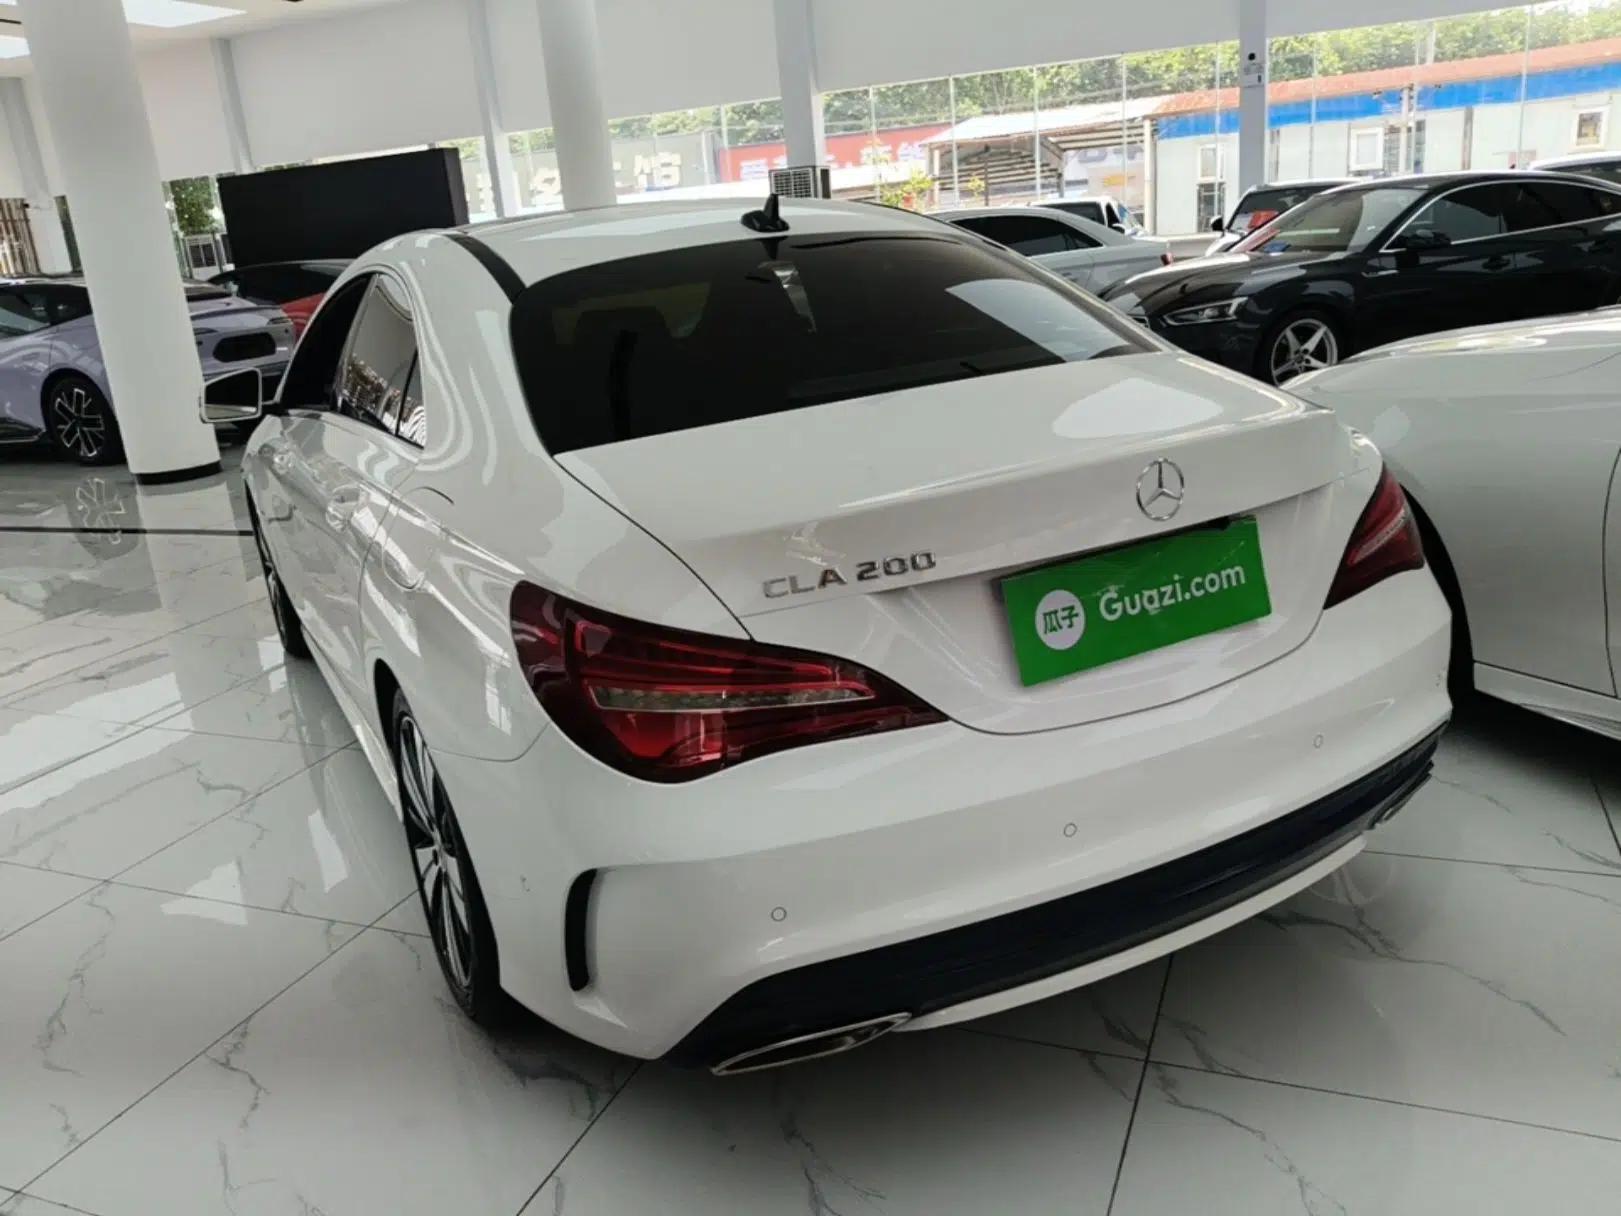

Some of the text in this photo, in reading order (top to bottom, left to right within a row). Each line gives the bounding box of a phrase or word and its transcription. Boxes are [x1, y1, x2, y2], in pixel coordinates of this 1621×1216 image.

[763, 551, 936, 598] CLA 200
[1099, 565, 1246, 621] Guazi.com
[1042, 605, 1079, 635] 瓜子
